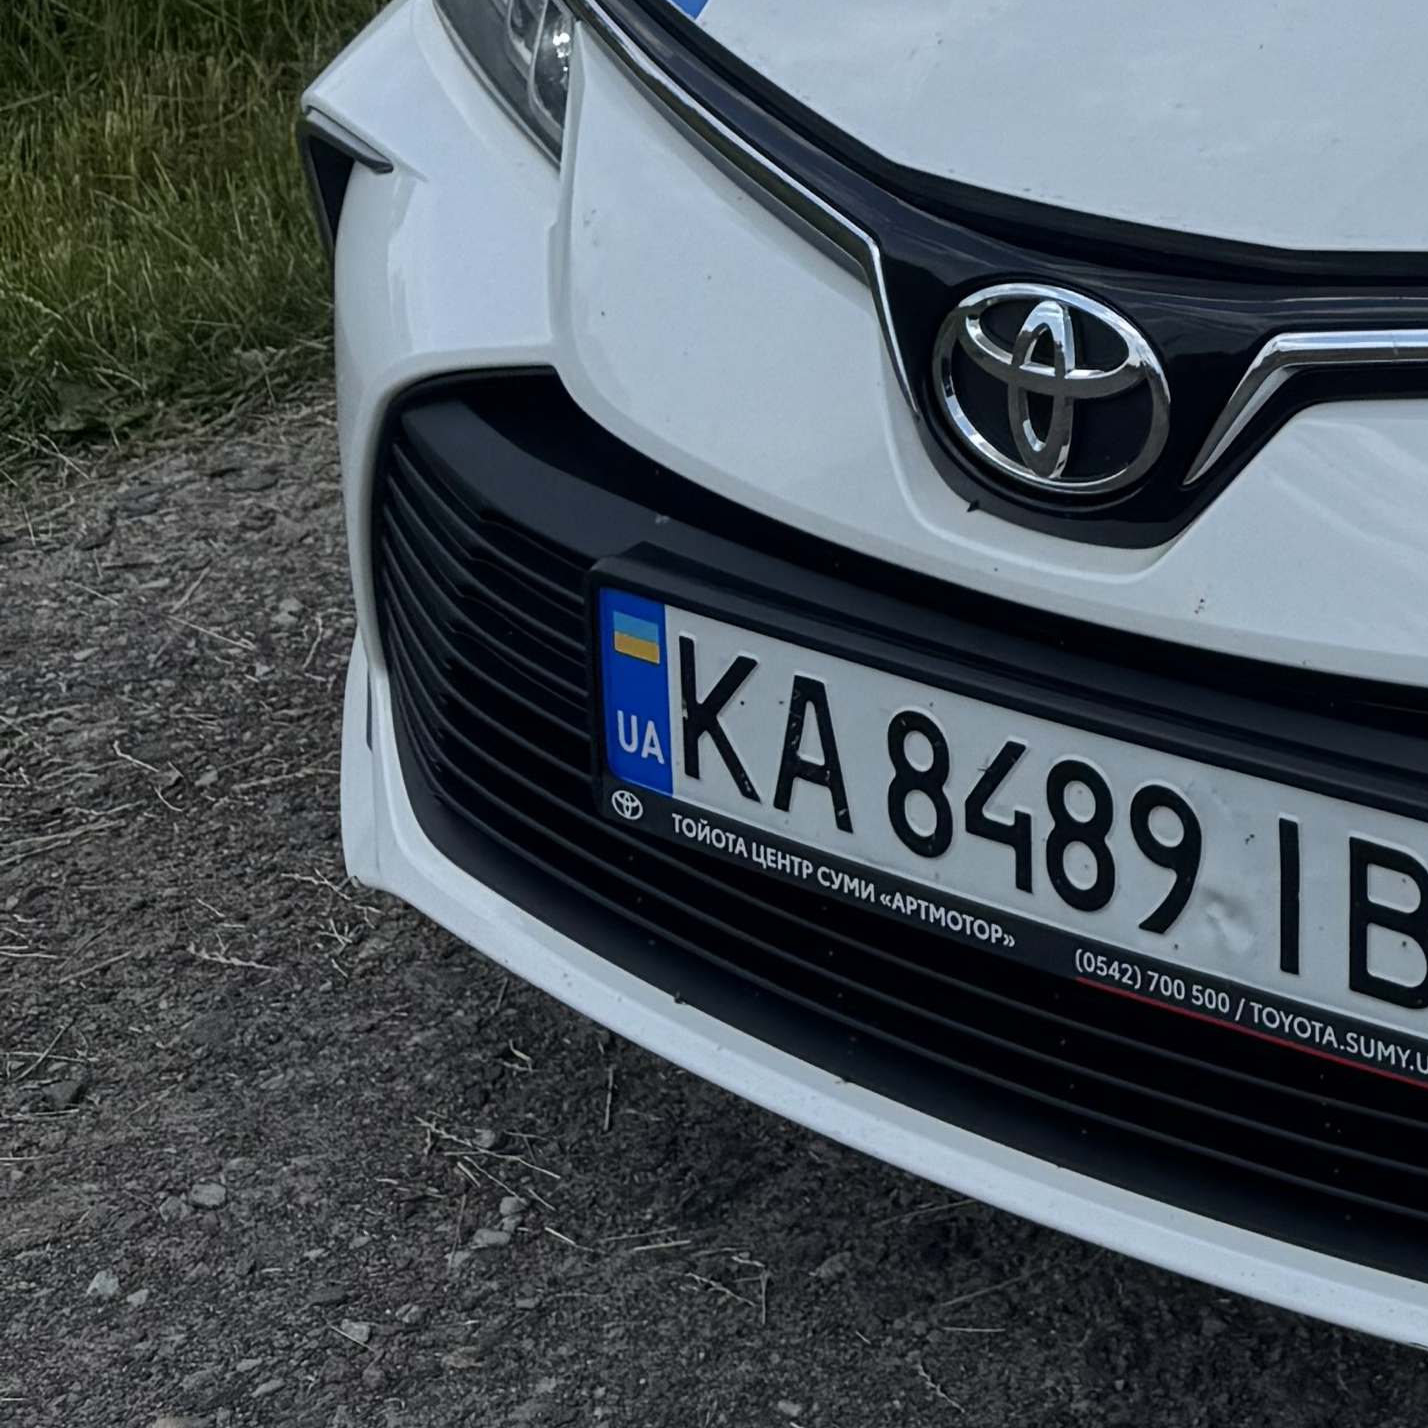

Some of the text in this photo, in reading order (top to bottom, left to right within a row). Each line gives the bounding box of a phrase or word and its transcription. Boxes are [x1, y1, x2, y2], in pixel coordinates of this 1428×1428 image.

[616, 709, 664, 765] UA
[886, 709, 1204, 936] 8489
[671, 813, 1016, 948] ТОЙОТА ЦЕНТР СУМИ «АРТМОТОР»
[1075, 948, 1142, 990] (0542)
[1147, 970, 1186, 1001] 700
[1191, 984, 1230, 1014] 500
[1234, 998, 1246, 1022] /
